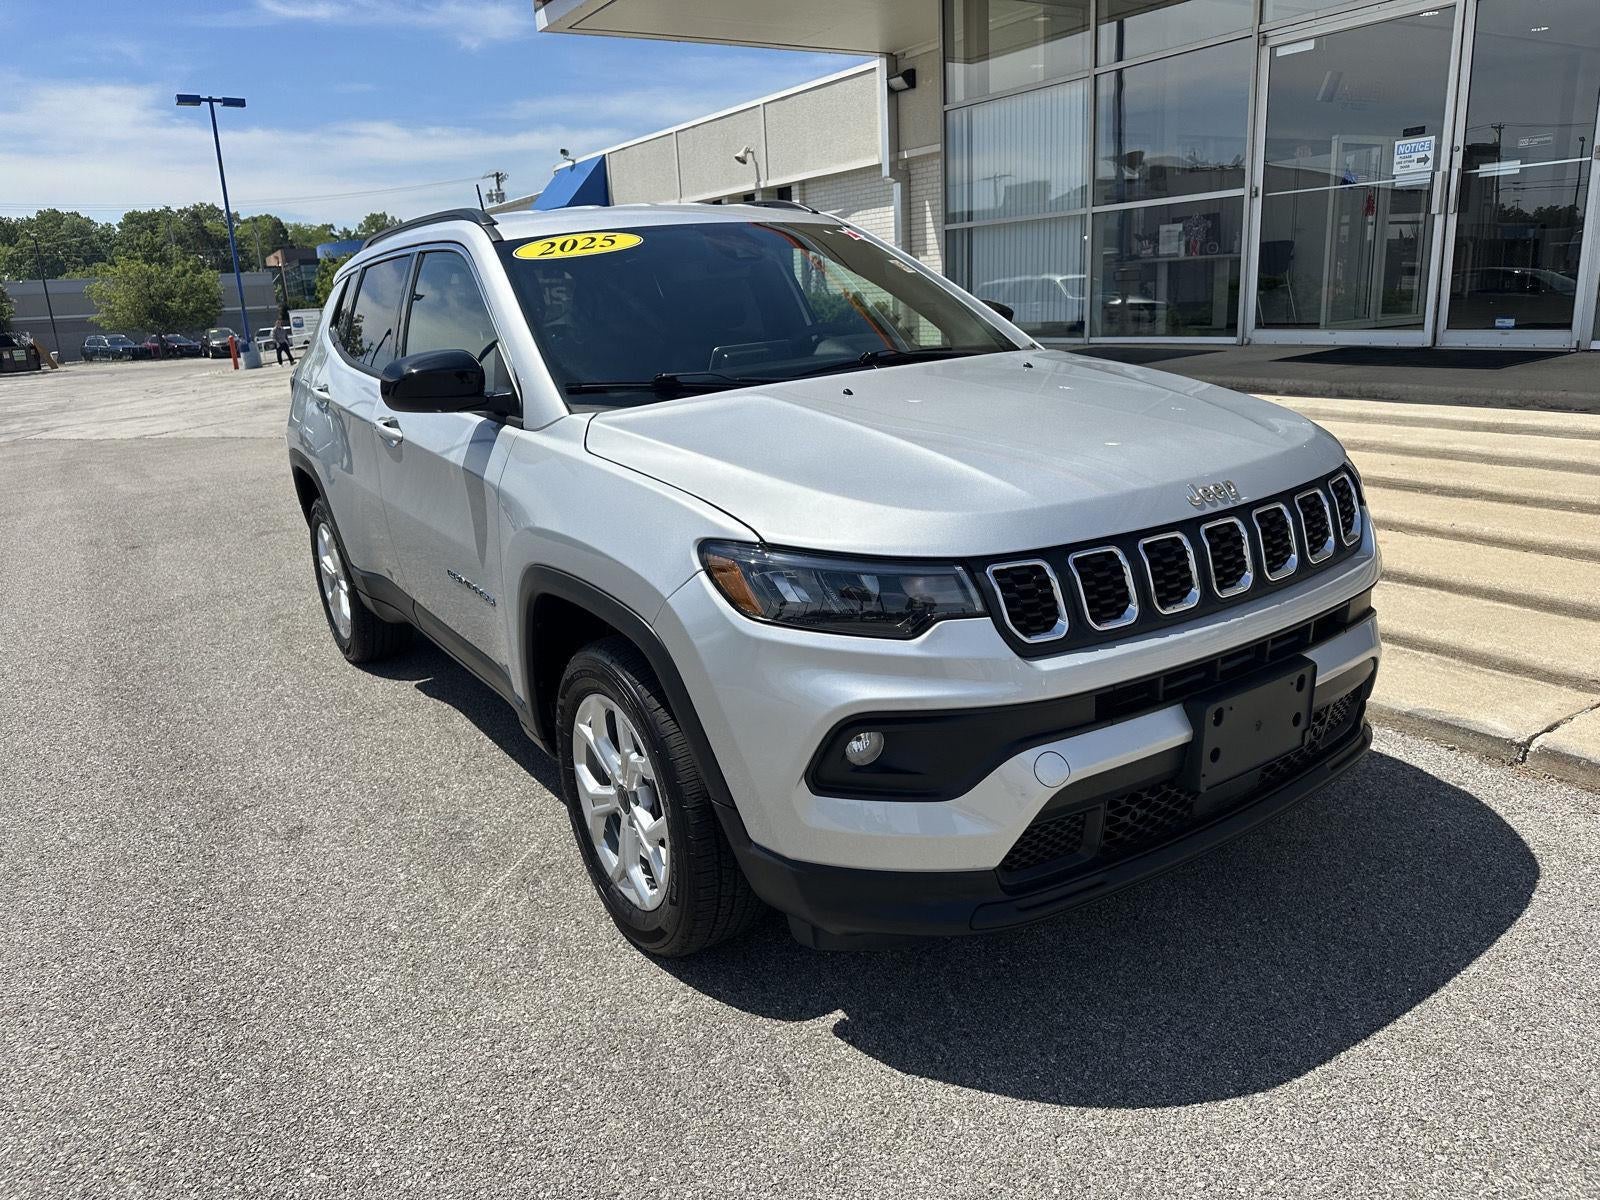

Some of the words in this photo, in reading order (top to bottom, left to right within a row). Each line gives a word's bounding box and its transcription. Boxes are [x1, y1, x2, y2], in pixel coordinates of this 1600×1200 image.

[1398, 141, 1430, 154] NOTICE
[538, 235, 617, 256] 2025
[1186, 480, 1237, 506] Jeep
